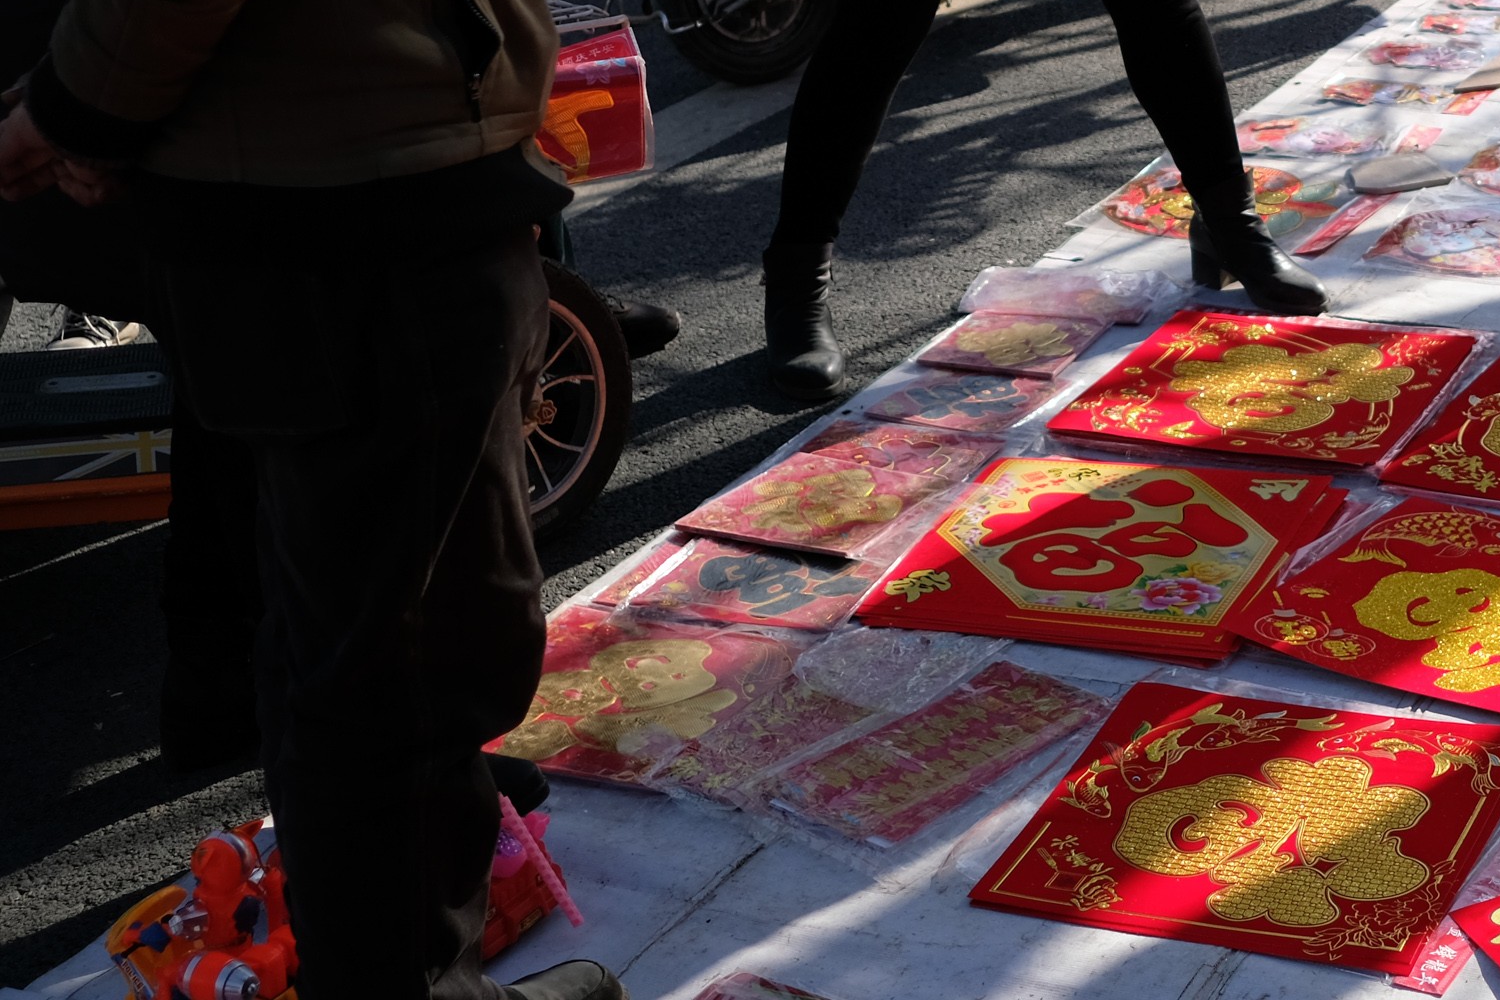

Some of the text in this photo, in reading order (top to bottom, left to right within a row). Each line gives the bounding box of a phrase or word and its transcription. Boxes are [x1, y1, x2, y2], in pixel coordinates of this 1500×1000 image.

[1170, 342, 1415, 433] 福
[1248, 477, 1309, 502] 全
[978, 478, 1249, 593] 福
[883, 567, 953, 602] 家
[1111, 754, 1432, 927] 福
